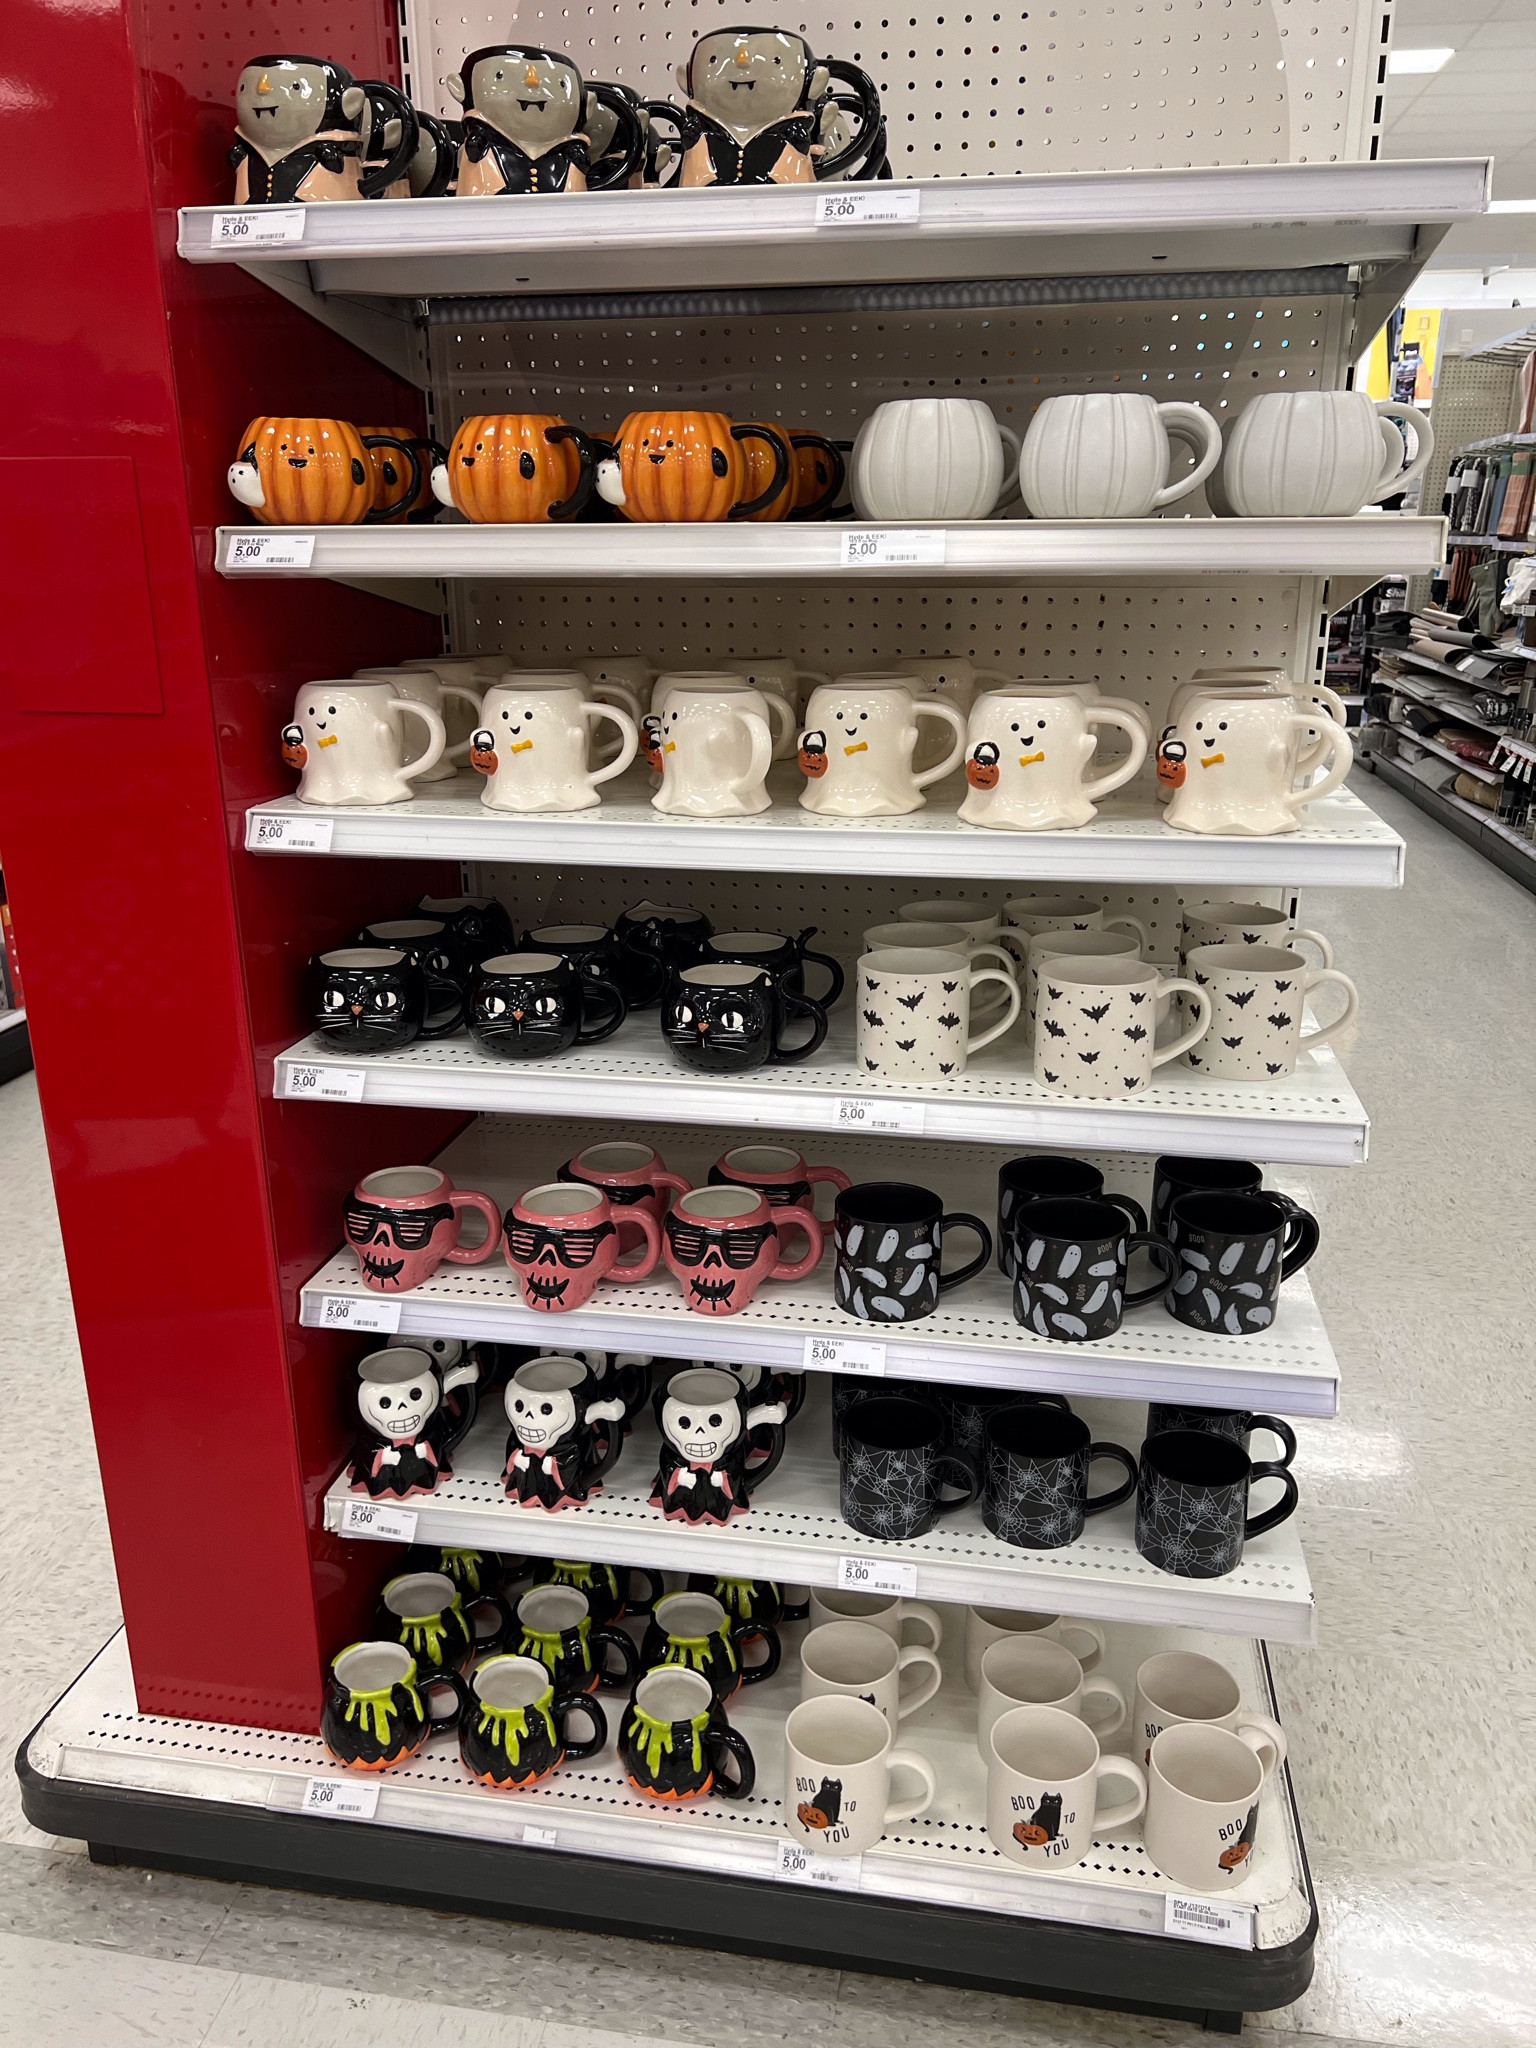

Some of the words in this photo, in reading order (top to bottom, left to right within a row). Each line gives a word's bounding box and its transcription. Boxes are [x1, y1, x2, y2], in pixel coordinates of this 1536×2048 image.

[825, 205, 855, 216] 5.00
[222, 225, 248, 236] 5.00
[235, 546, 261, 556] 5.00
[849, 543, 877, 555] 5.00
[259, 827, 282, 837] 5.00
[293, 1075, 316, 1086] 5.00
[840, 1108, 865, 1119] 5.00
[327, 1307, 348, 1317] 5.00
[812, 1348, 836, 1359] 5.00
[351, 1511, 372, 1523] 5.00
[846, 1568, 868, 1579] 5.00
[796, 1777, 816, 1792] BOO
[311, 1790, 333, 1801] 5.00
[844, 1801, 856, 1812] TO
[1011, 1796, 1035, 1810] BOO
[1064, 1812, 1075, 1824] TO
[823, 1826, 850, 1843] YOU
[1219, 1819, 1242, 1840] BOO
[1044, 1838, 1069, 1857] YOU
[783, 1856, 806, 1870] 5.00
